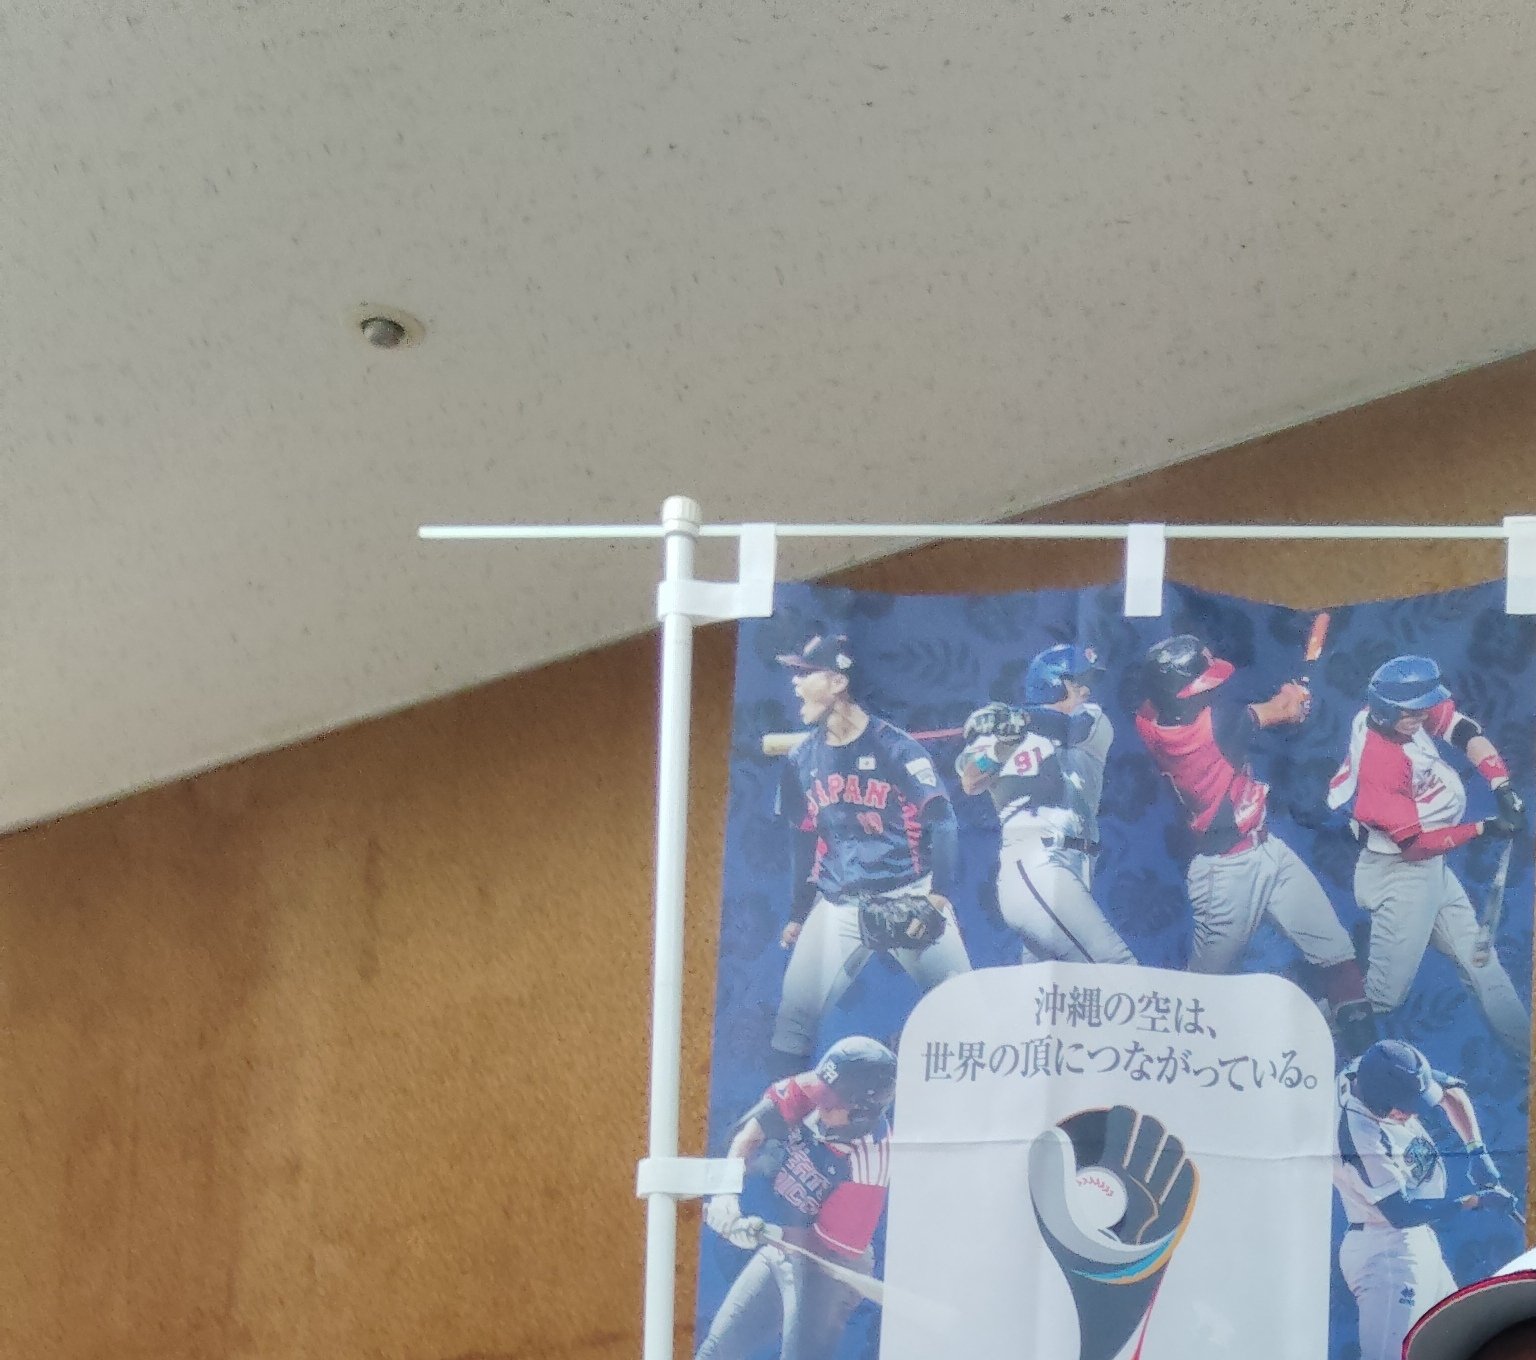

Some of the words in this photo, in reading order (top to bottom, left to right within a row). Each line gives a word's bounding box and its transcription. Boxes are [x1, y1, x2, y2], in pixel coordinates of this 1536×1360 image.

[1034, 983, 1217, 1039] 沖縄の空は、
[921, 1034, 1318, 1092] 世界の頂につながっている。
